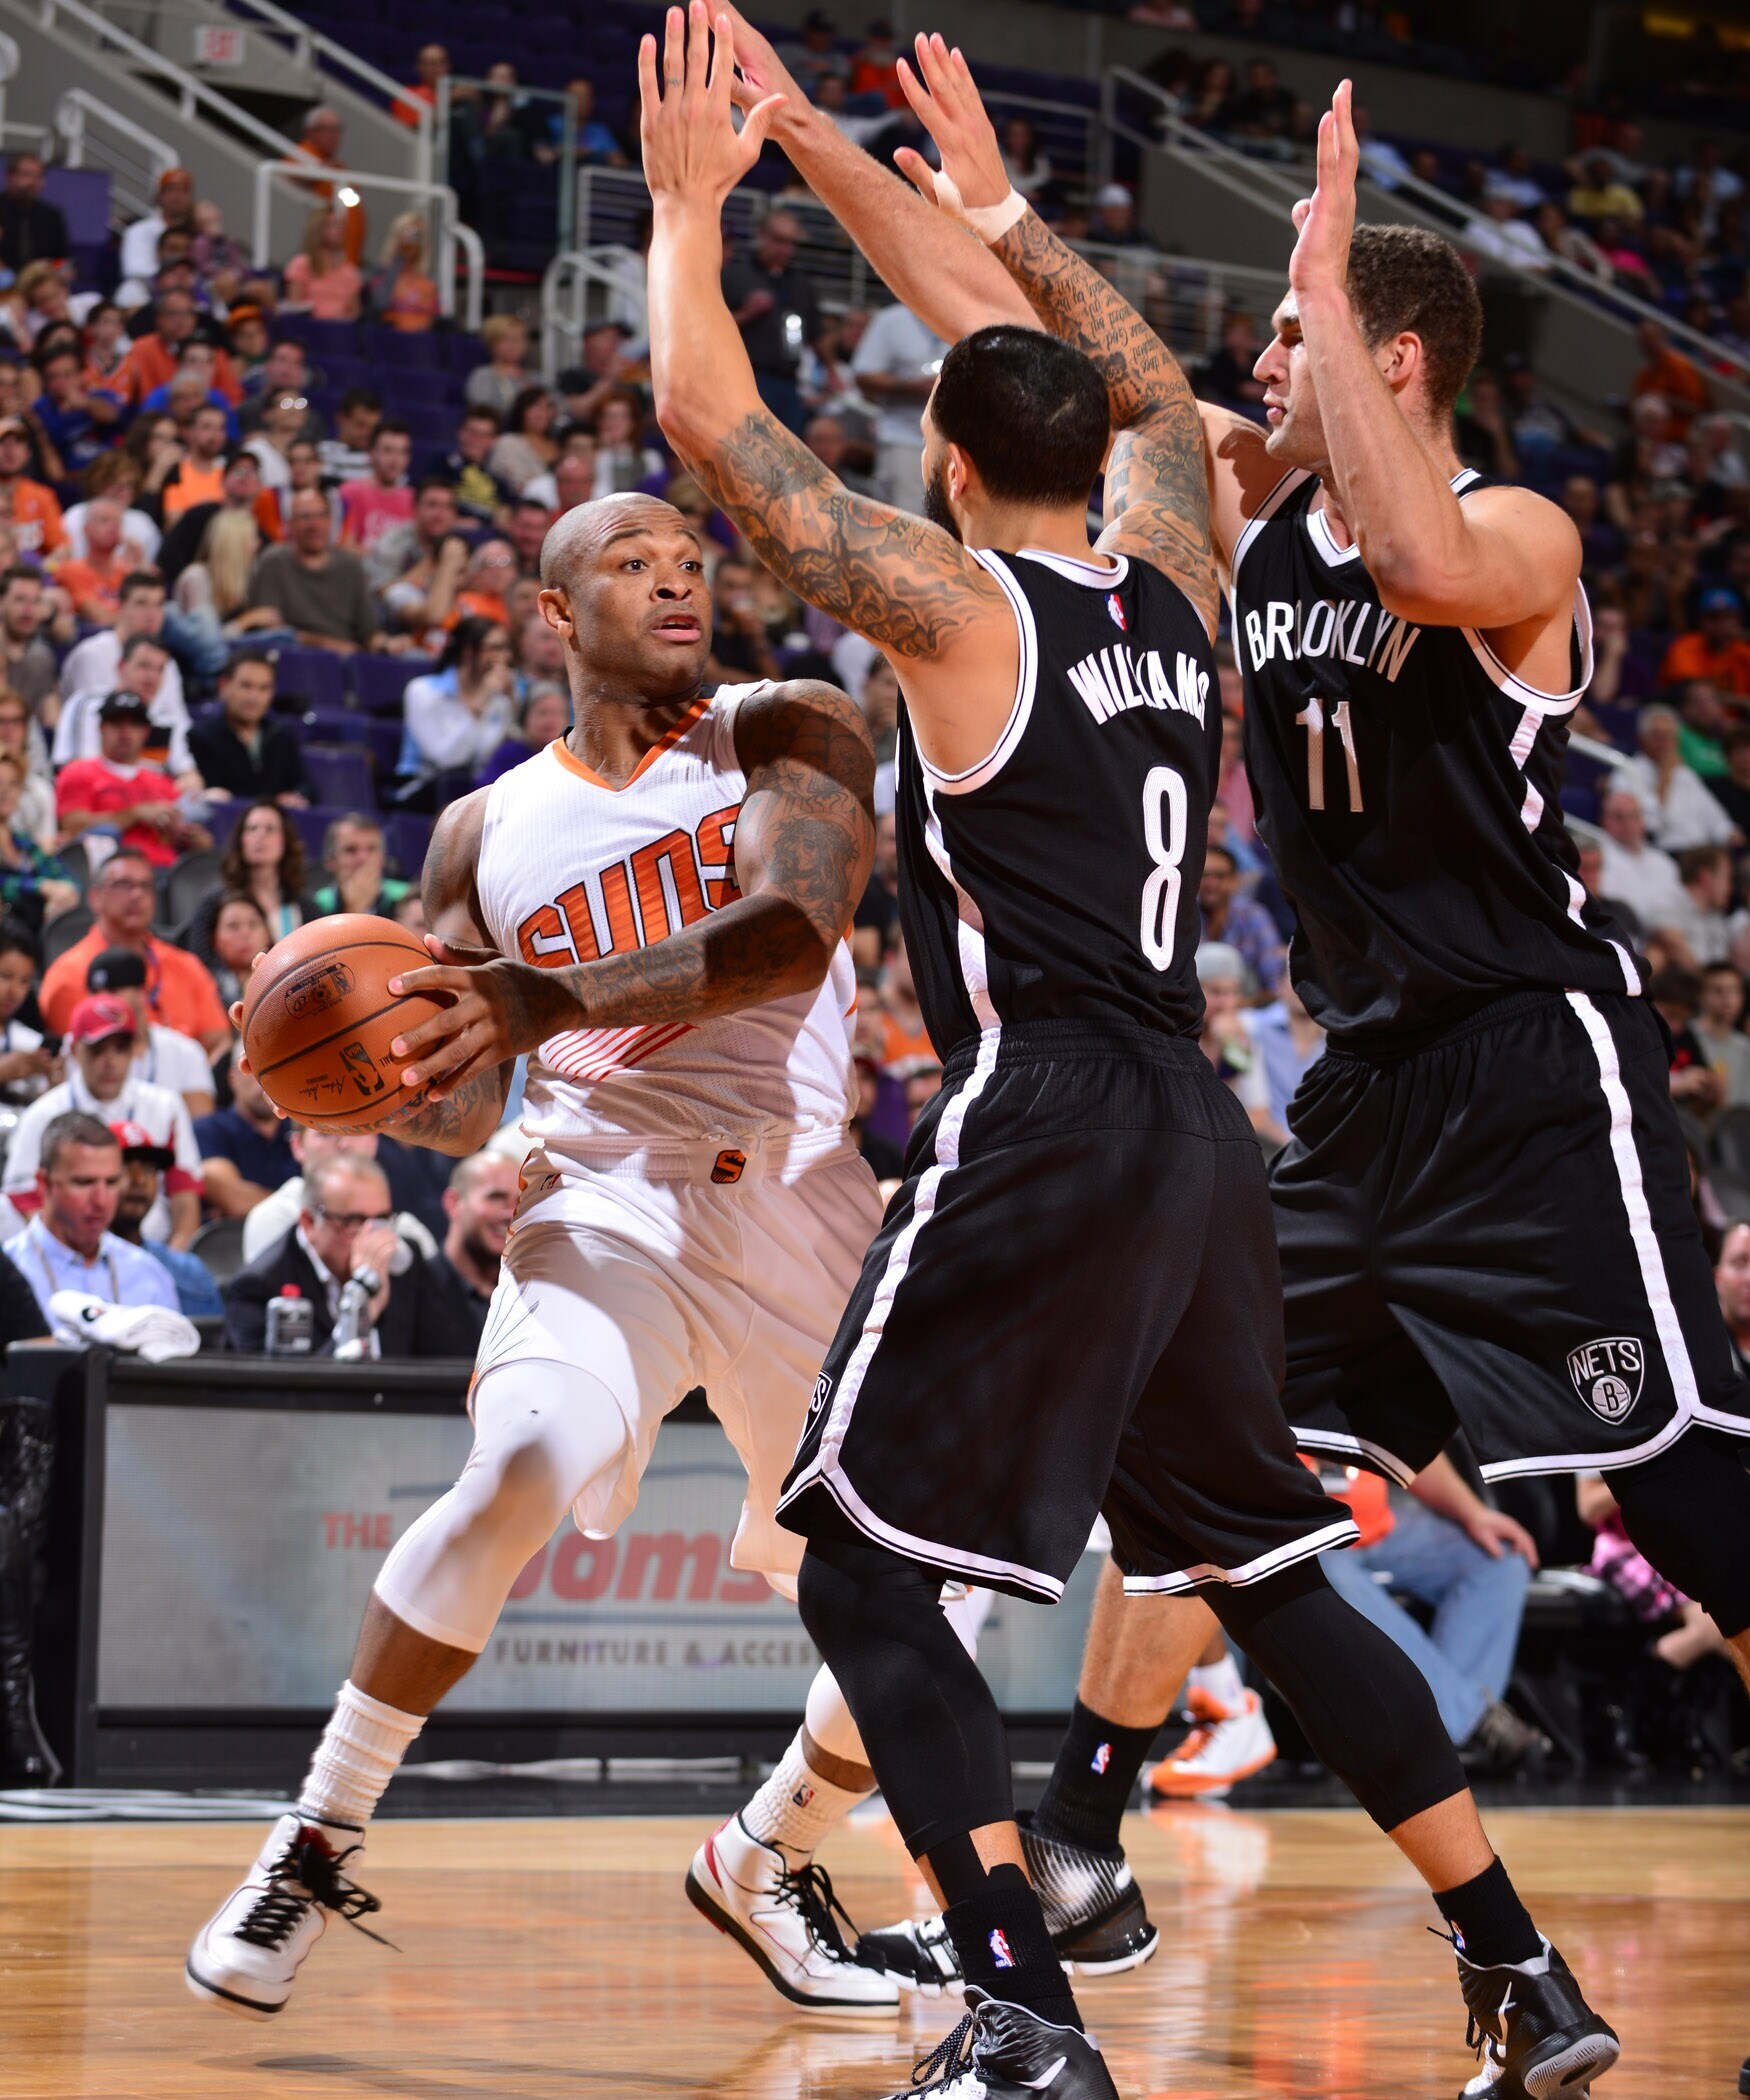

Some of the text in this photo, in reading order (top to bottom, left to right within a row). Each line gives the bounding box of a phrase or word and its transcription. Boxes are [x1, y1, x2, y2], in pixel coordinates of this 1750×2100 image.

[1245, 599, 1421, 683] BROOKLYN
[1066, 642, 1210, 732] WILLIAMS
[1296, 698, 1363, 812] 11
[517, 802, 742, 969] SUNS
[1140, 766, 1188, 971] 8
[1571, 1341, 1640, 1386] NETS
[1602, 1382, 1620, 1412] B
[322, 1511, 394, 1551] THE
[496, 1637, 668, 1667] FURNITURE
